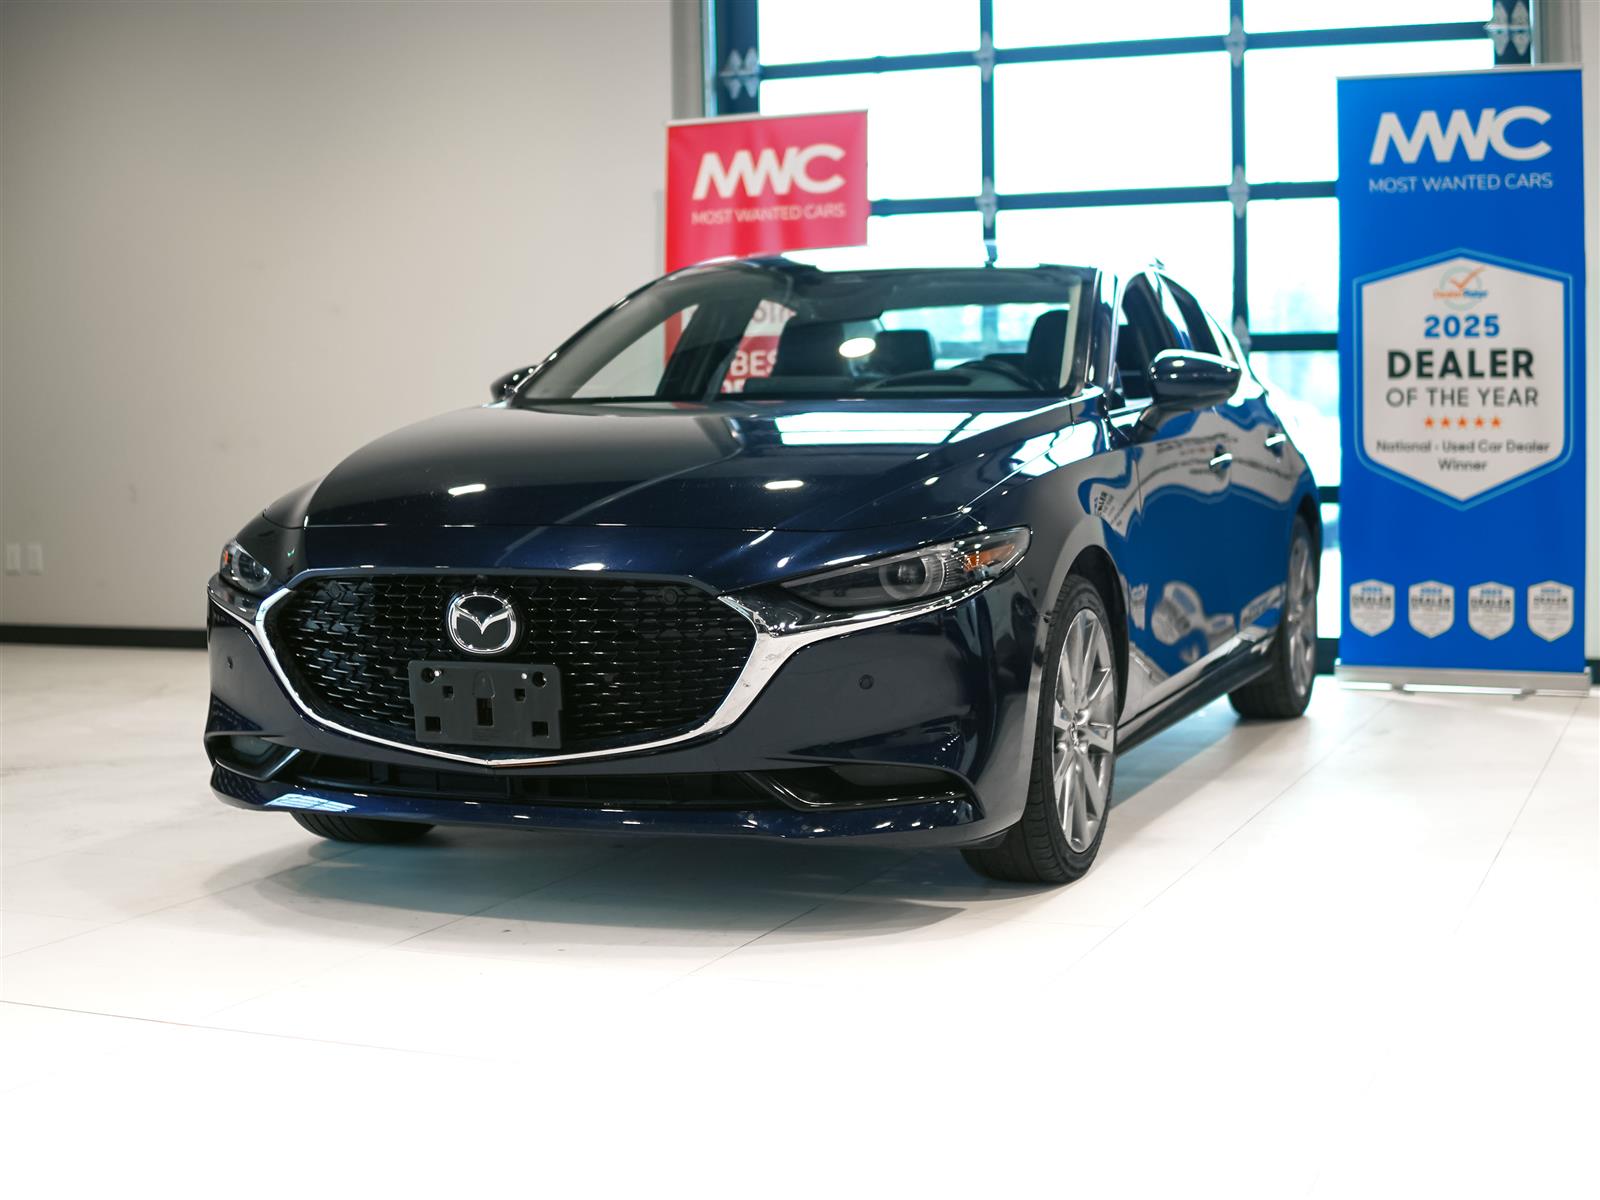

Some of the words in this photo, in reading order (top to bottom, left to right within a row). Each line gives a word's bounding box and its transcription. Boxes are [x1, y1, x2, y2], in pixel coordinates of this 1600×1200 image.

[1369, 105, 1552, 165] MWC
[692, 143, 846, 201] MWC
[1369, 176, 1417, 193] MOST
[1422, 174, 1500, 192] WANTED
[1504, 172, 1553, 190] CARS
[691, 207, 733, 225] MOST
[734, 204, 801, 222] WANTED
[803, 202, 847, 219] CARS
[1424, 314, 1501, 339] 2025
[1387, 348, 1535, 379] DEALER
[1386, 387, 1418, 408] OF
[1426, 387, 1469, 408] THE
[1477, 387, 1539, 408] YEAR
[1376, 439, 1432, 454] National
[1442, 439, 1475, 454] Used
[1478, 439, 1503, 454] Car
[1506, 438, 1550, 454] Dealer
[1438, 458, 1487, 472] Winner
